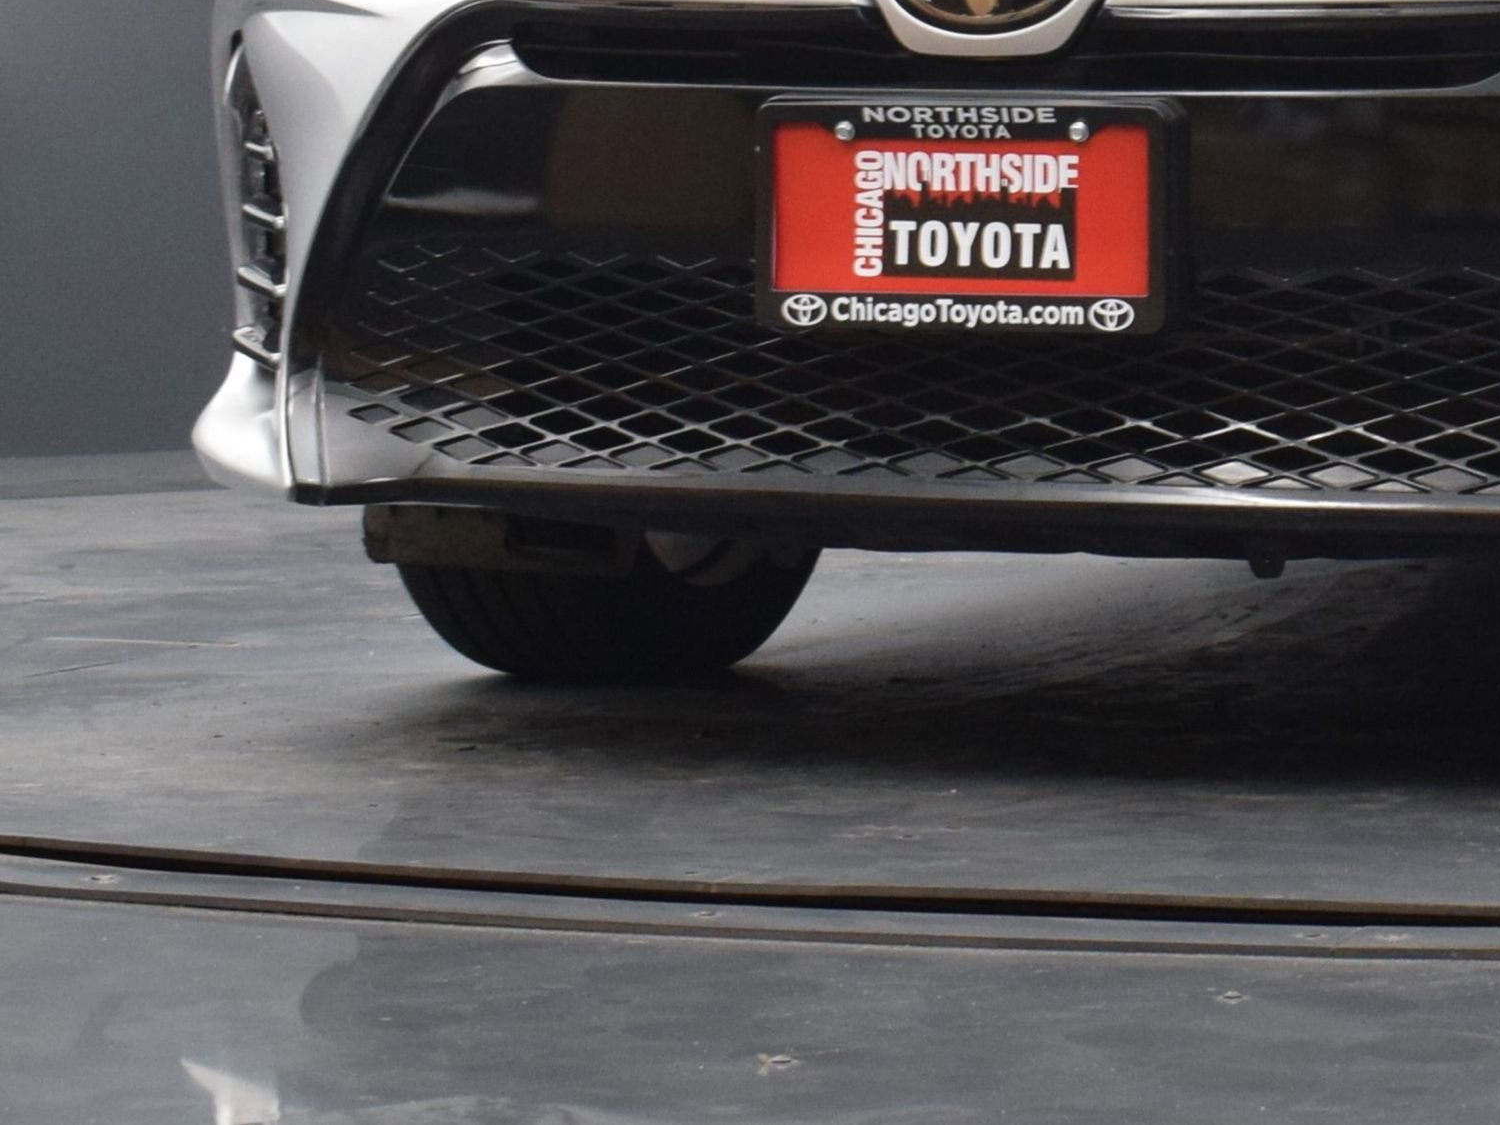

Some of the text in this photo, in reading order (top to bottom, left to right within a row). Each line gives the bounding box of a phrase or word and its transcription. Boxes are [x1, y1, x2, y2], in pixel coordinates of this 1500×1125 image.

[862, 107, 1057, 123] NORTHSIDE
[912, 124, 1011, 139] TOYOTA
[884, 151, 1080, 193] NORTHSIDE
[853, 150, 885, 277] CHICAGO
[890, 221, 1070, 268] TOYOTA
[831, 296, 1085, 327] ChicagoToyota.com
